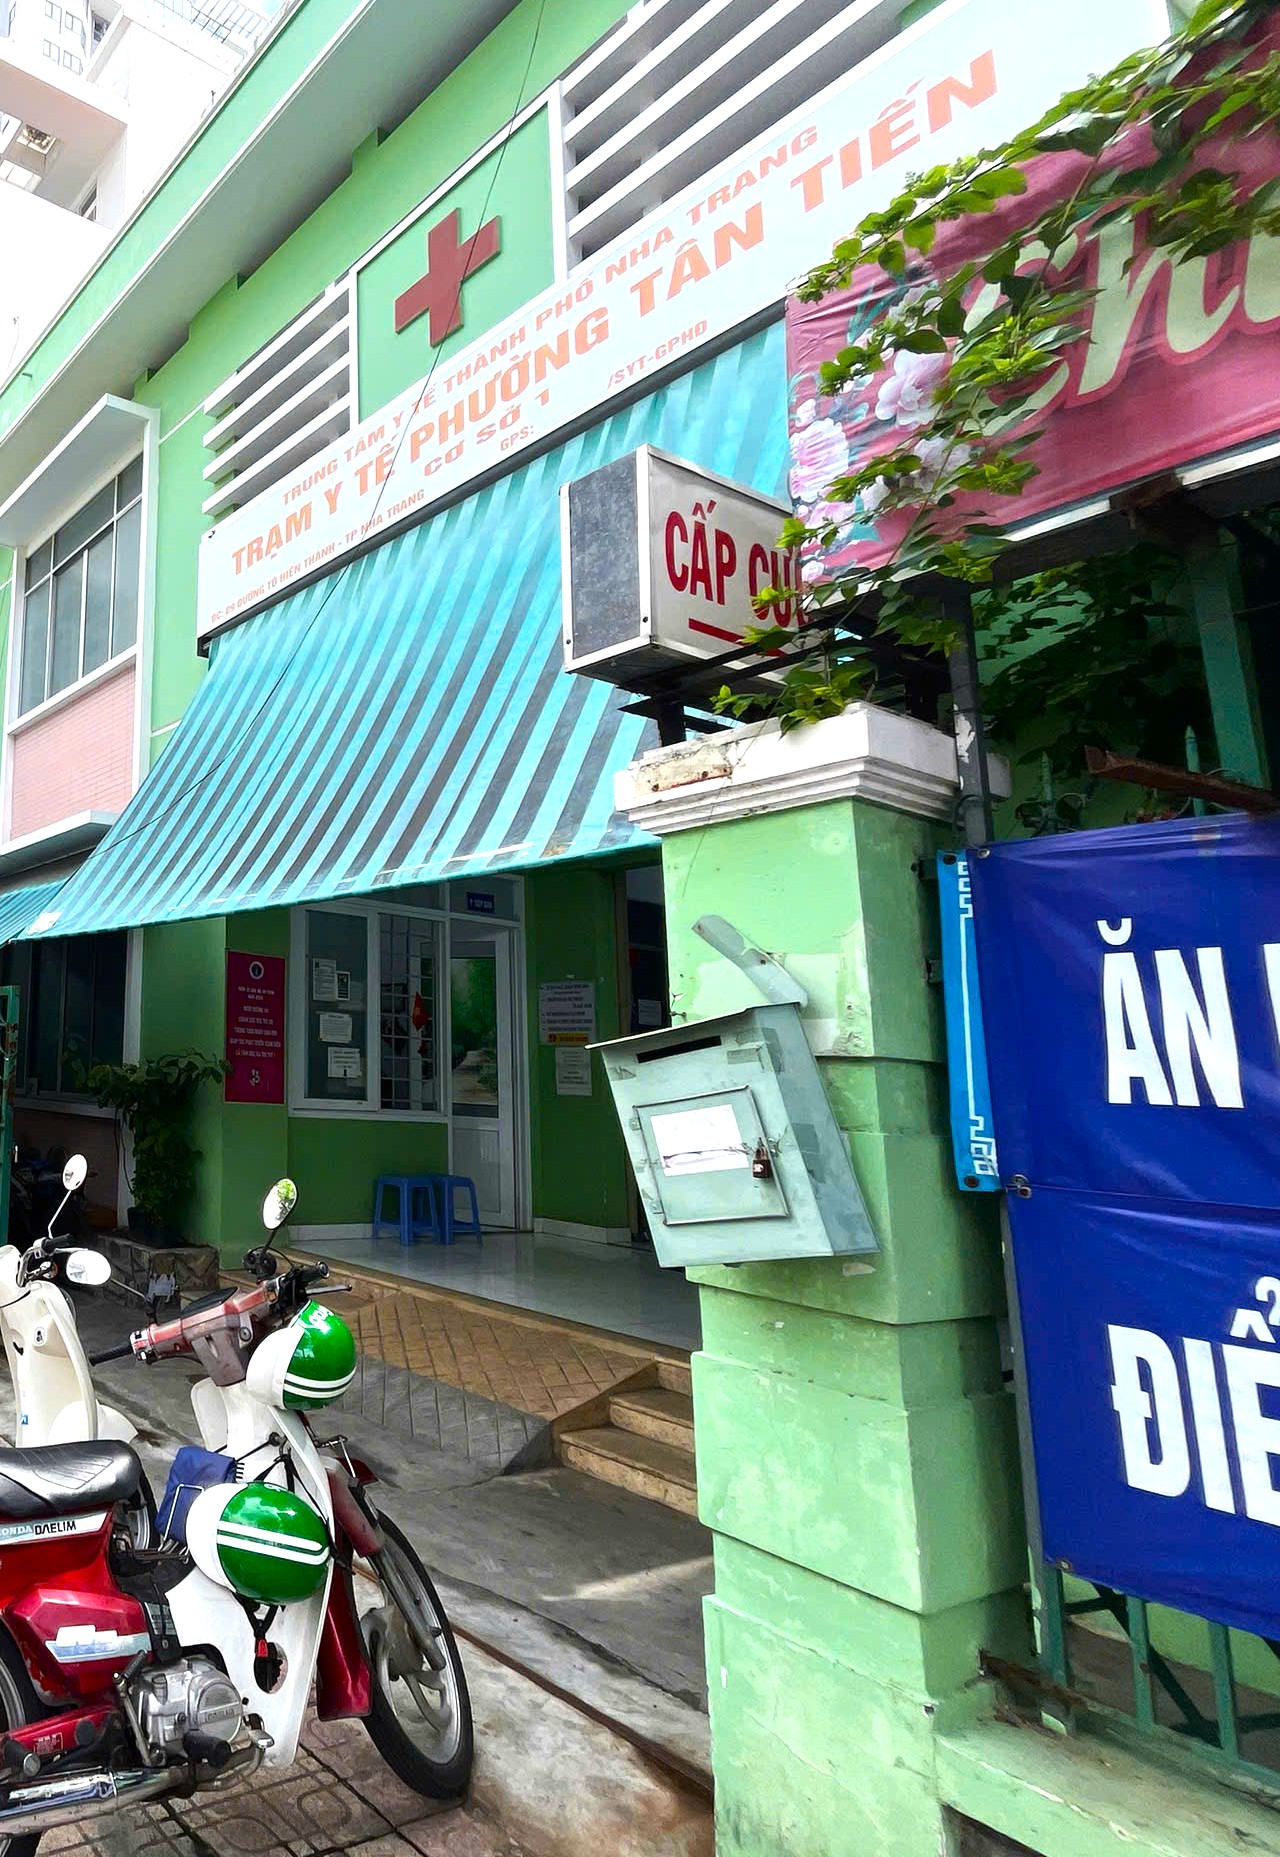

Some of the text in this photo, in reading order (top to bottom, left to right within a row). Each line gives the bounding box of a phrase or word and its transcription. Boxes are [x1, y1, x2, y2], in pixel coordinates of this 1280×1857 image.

[231, 48, 998, 576] TRẠM Y TẾ PHƯỜNG TÂN TIẾN
[282, 124, 818, 505] TRUNG TÂM Y TẾ THÀNH PHỐ NHA TRANG
[423, 439, 466, 477] CƠ
[534, 387, 550, 407] 1
[345, 529, 357, 543] TP
[360, 514, 384, 535] NHA
[387, 488, 425, 518] TRANG
[665, 499, 737, 606] CẤP
[1097, 917, 1244, 1109] ĂN
[34, 1520, 76, 1535] DAELIM
